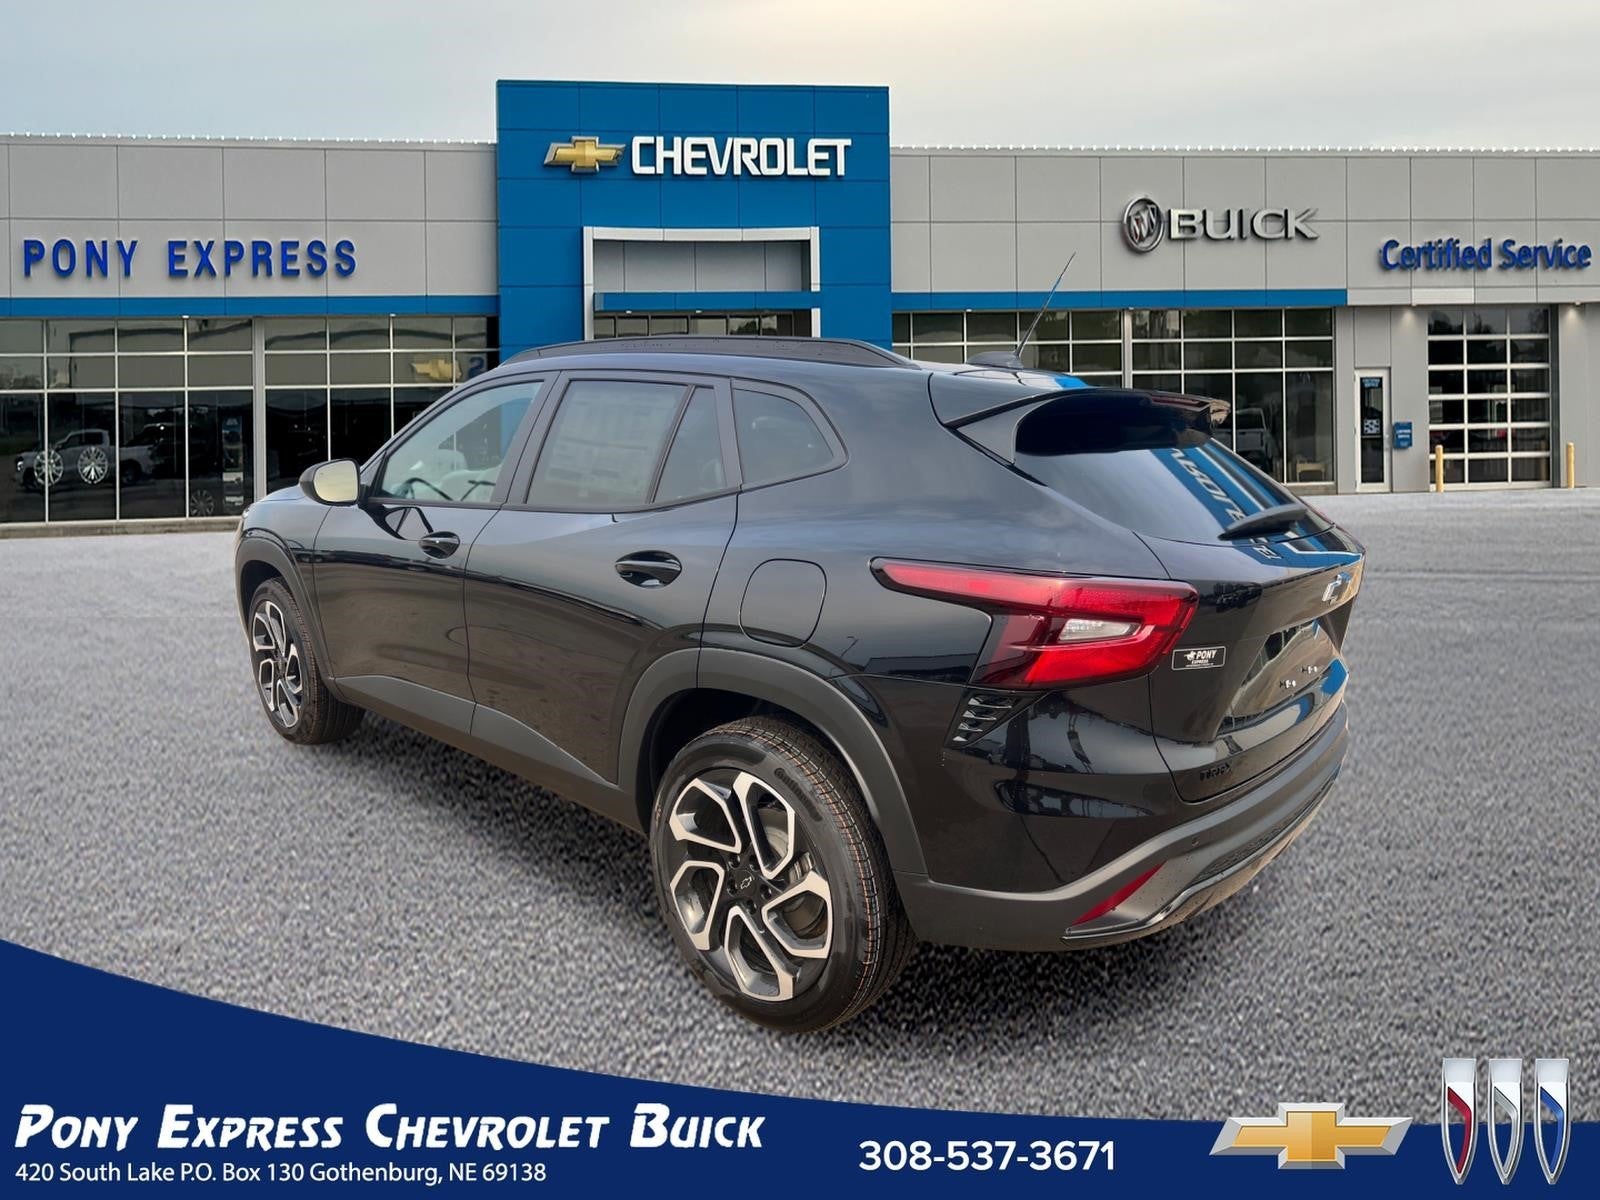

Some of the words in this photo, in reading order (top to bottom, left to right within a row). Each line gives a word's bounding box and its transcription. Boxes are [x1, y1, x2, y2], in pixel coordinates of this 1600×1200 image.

[631, 135, 852, 178] CHEVROLET
[1169, 207, 1320, 241] BUICK
[23, 239, 137, 278] PONY
[167, 240, 357, 278] EXPRESS
[1379, 238, 1493, 270] Certified
[1499, 238, 1592, 270] Service
[1195, 650, 1217, 660] PONY
